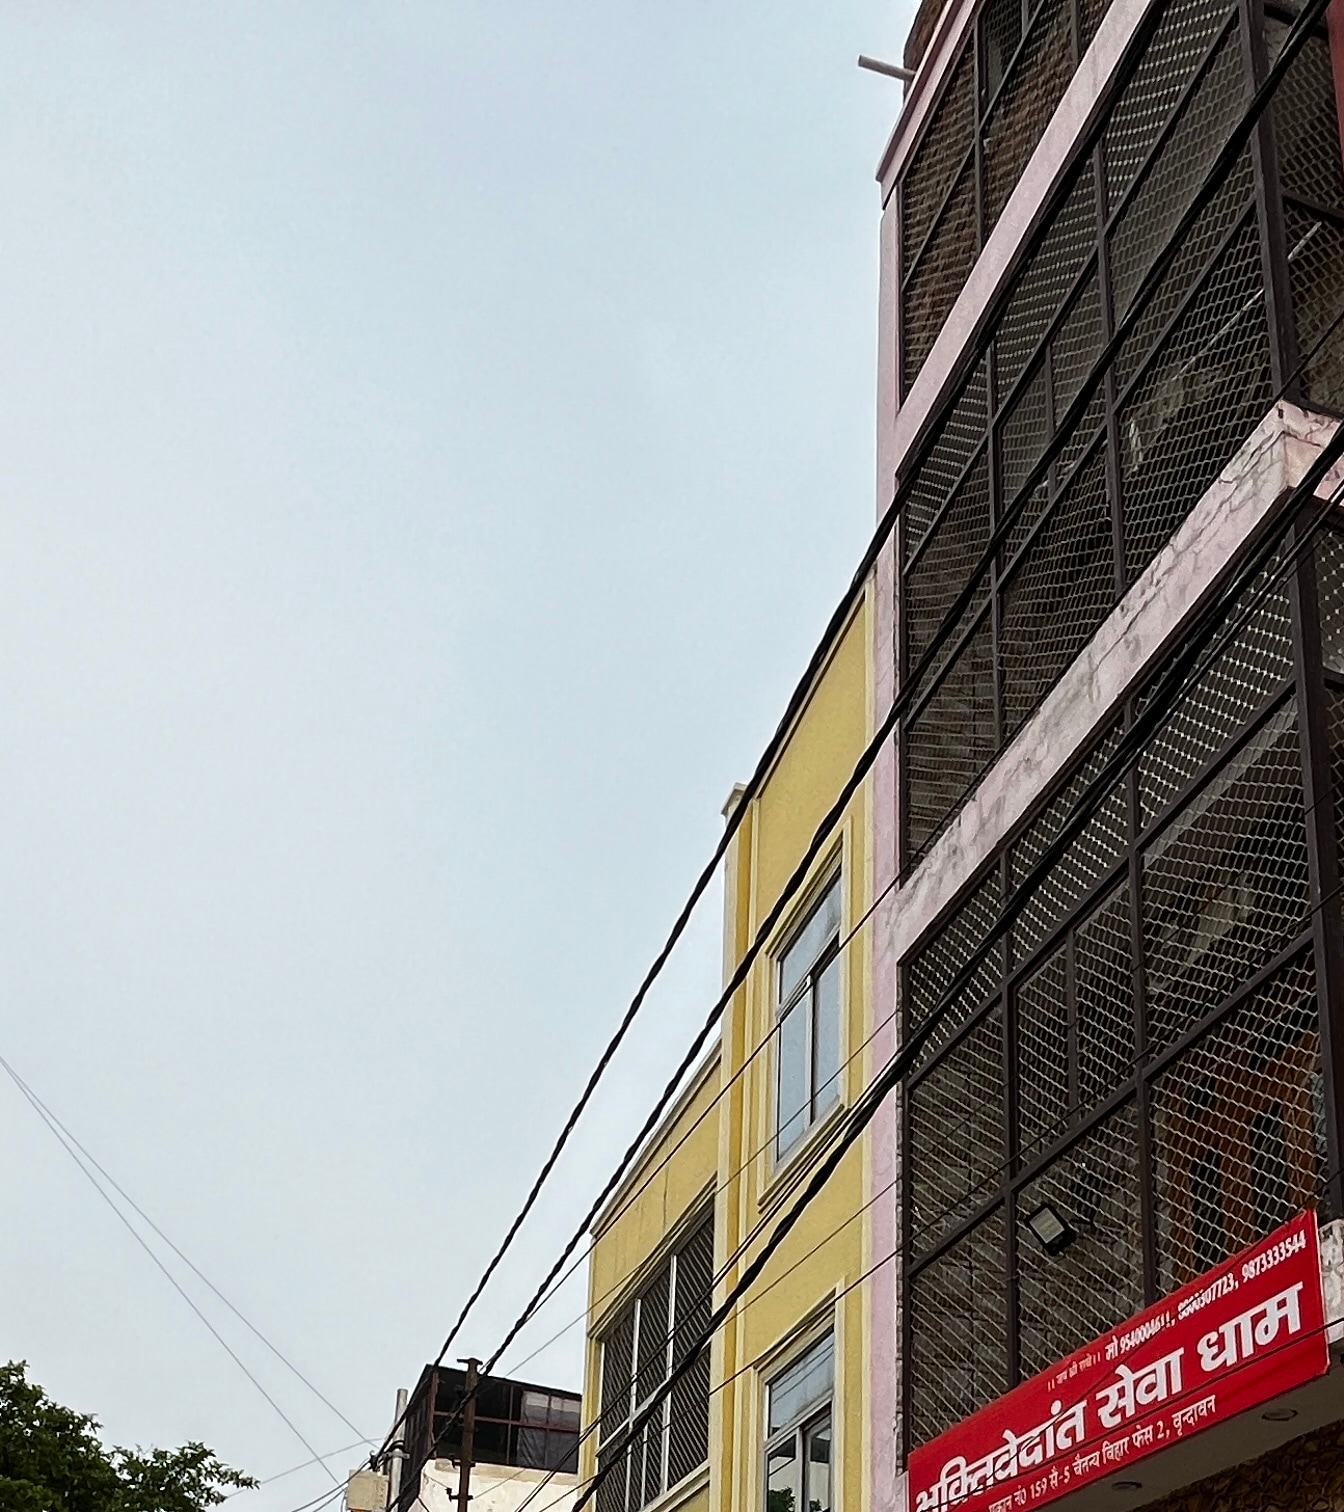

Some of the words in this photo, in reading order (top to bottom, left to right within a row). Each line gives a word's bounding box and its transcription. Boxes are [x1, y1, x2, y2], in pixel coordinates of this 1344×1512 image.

[1096, 1346, 1185, 1430] सेवा
[1196, 1282, 1304, 1374] धाम
[1105, 1335, 1119, 1361] मो
[1241, 1229, 1307, 1283] 9873333544
[1030, 1477, 1048, 1499] 159
[1072, 1453, 1101, 1477] चैतन्य
[1102, 1436, 1130, 1465] विहार
[1171, 1394, 1217, 1437] वृन्दावन
